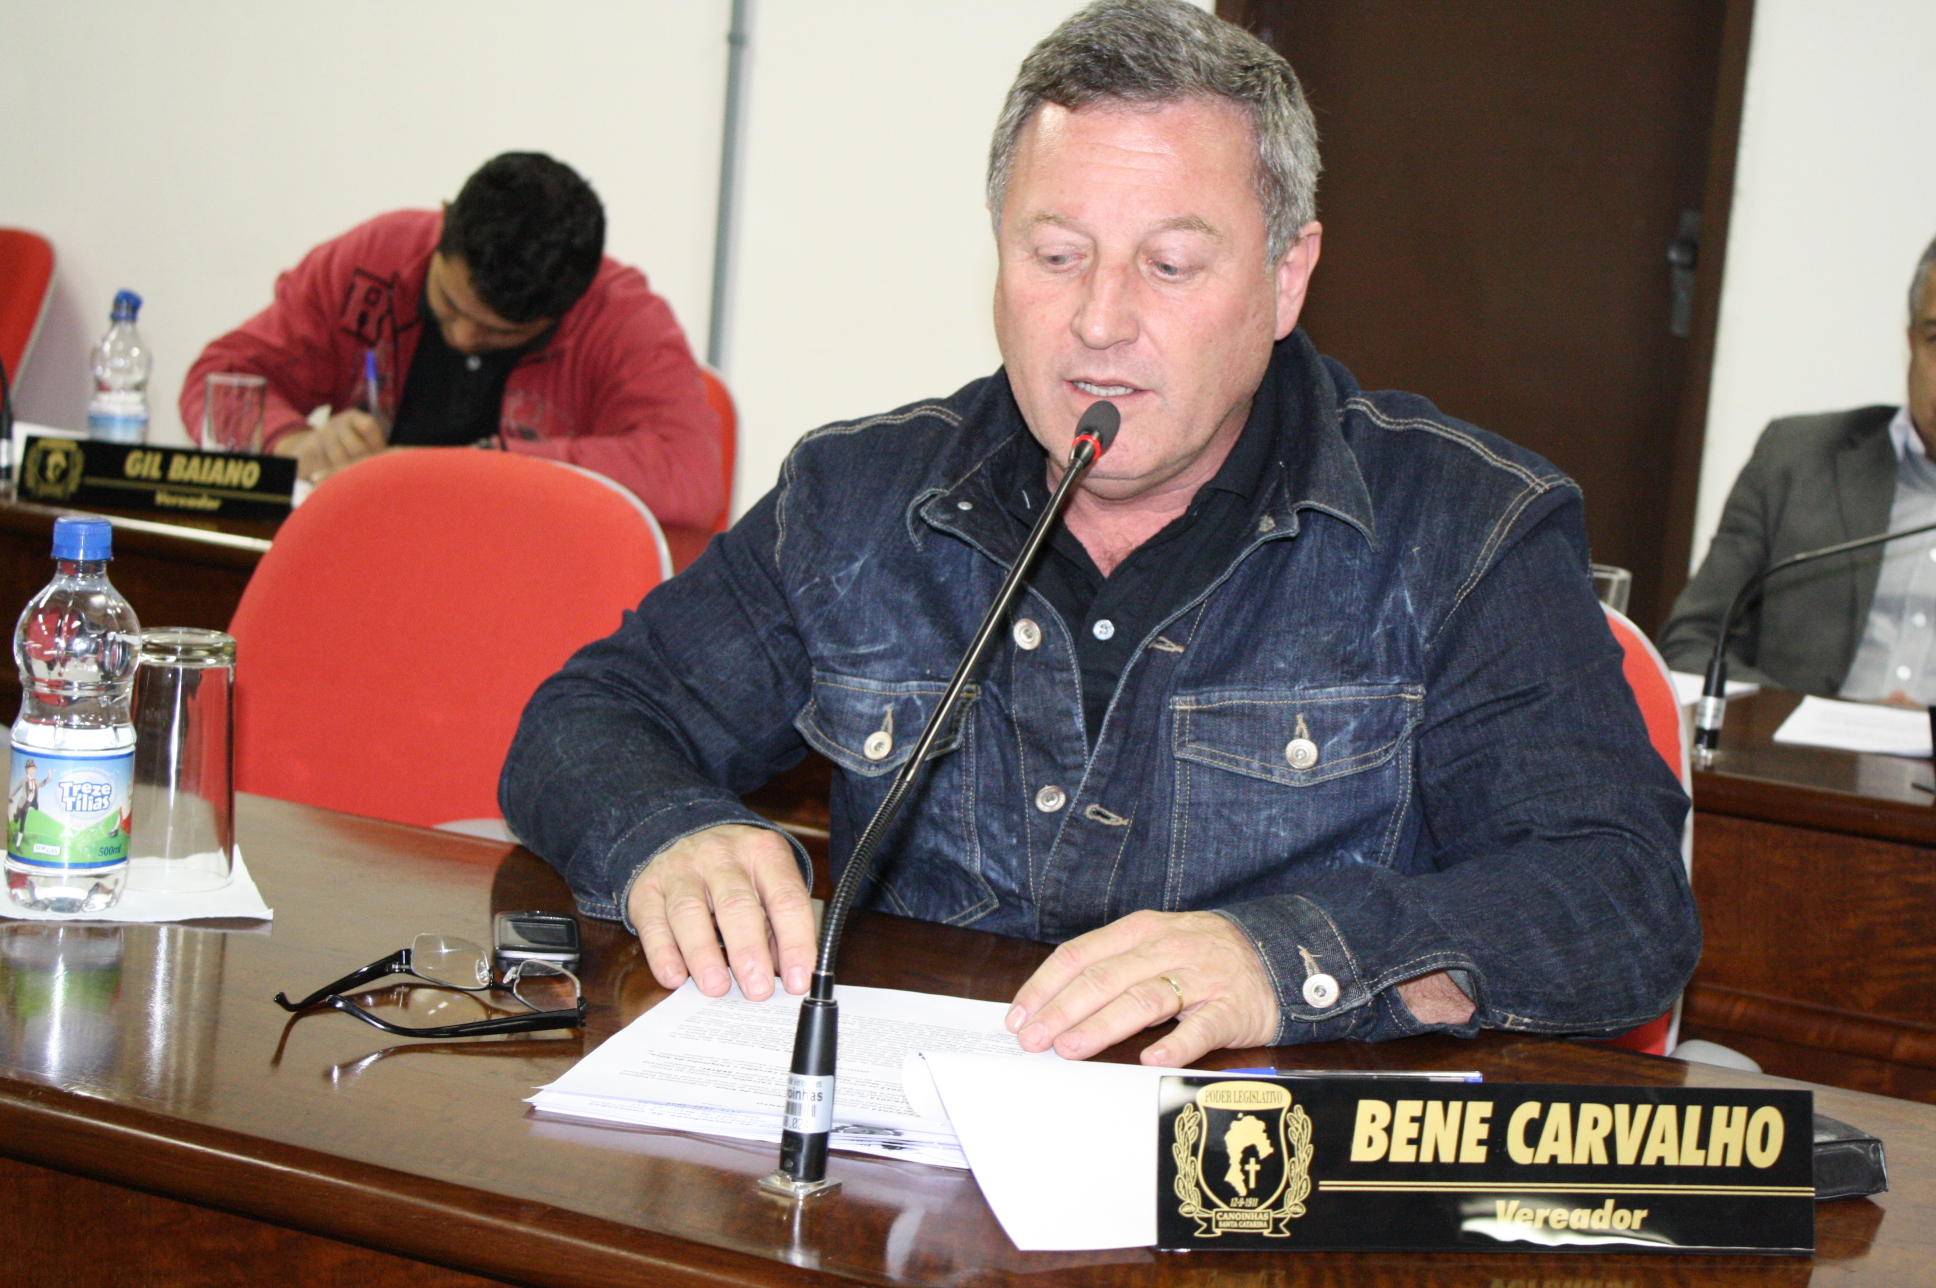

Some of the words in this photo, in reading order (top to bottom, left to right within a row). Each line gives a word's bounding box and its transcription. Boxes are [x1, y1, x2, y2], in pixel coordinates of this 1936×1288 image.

[124, 449, 163, 480] GIL
[167, 453, 261, 489] BAIANO
[59, 781, 112, 797] Treze
[61, 793, 111, 812] Tílias
[98, 844, 122, 857] 500ml
[1205, 1090, 1232, 1103] PODER
[1233, 1090, 1283, 1104] LEGISLATIVO
[1350, 1099, 1494, 1163] BENE
[1506, 1101, 1785, 1168] CARVALHO
[1216, 1212, 1269, 1220] CANOINHAS
[1495, 1199, 1649, 1231] Vereador
